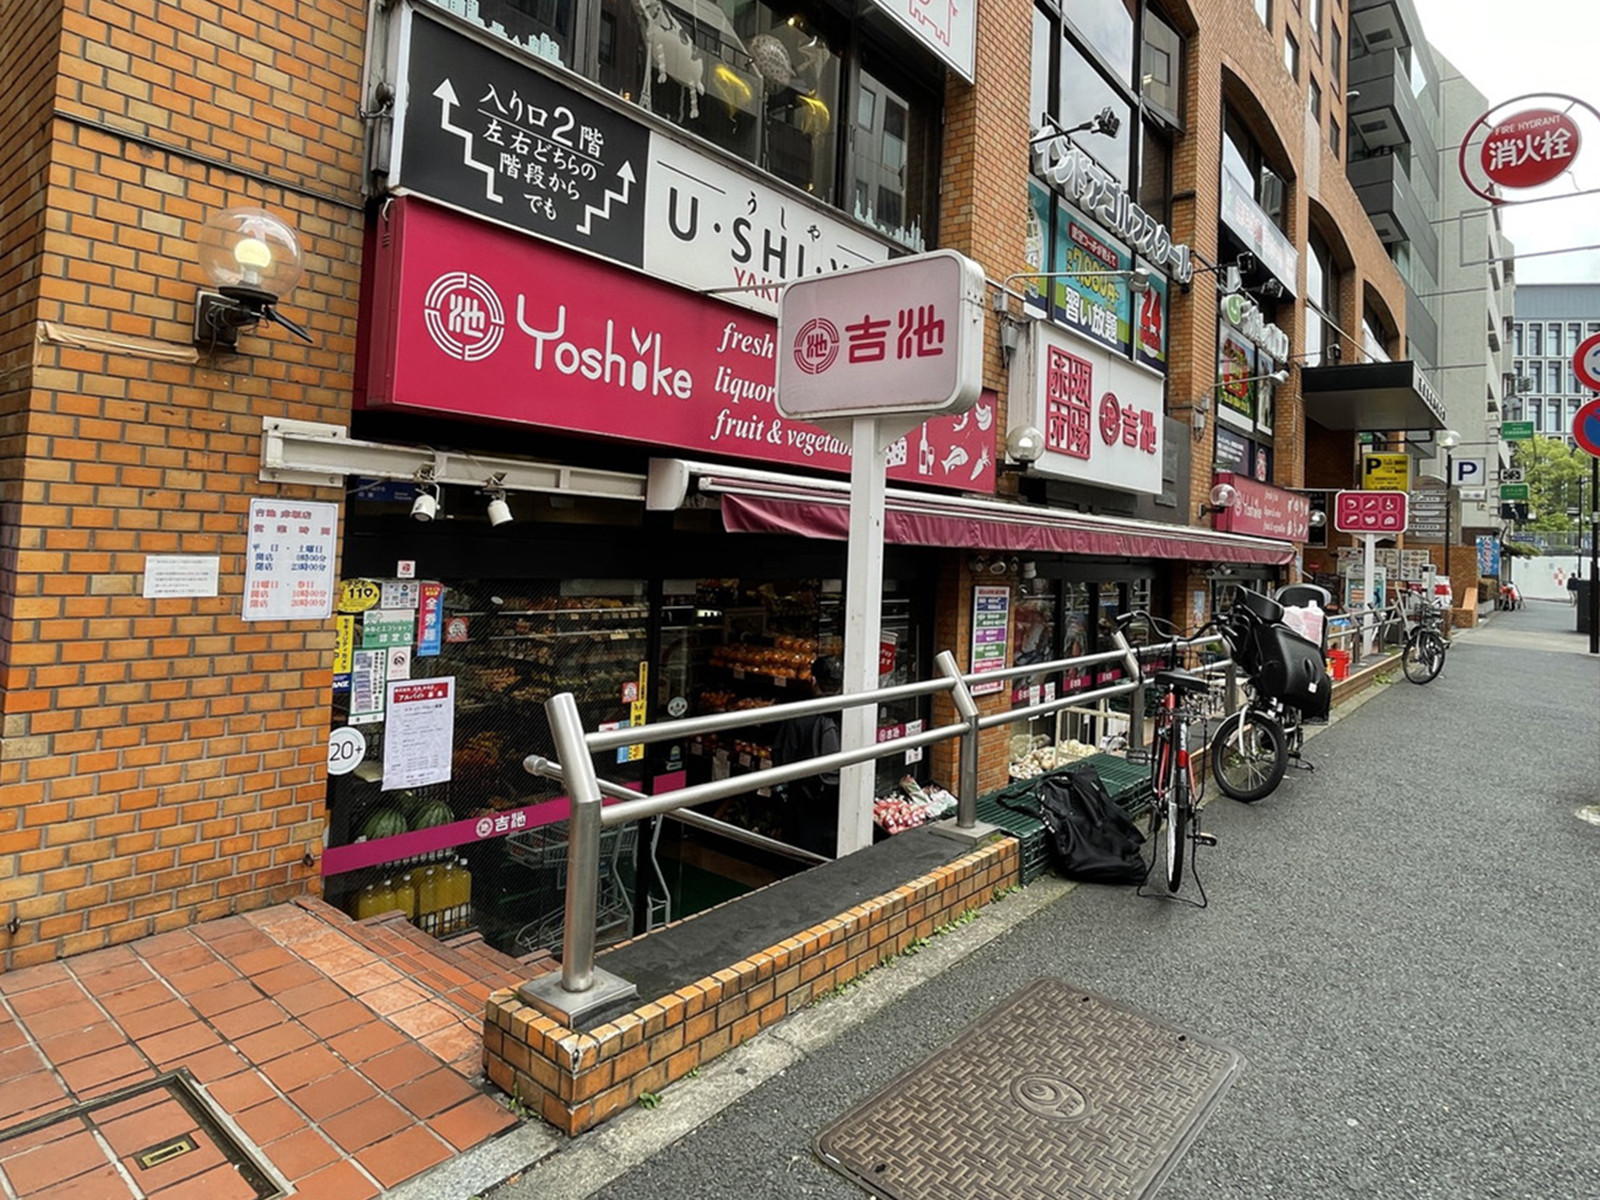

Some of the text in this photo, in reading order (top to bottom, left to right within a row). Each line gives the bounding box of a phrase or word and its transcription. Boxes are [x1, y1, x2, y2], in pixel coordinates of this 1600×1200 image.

[479, 83, 604, 158] 入り口2階
[1494, 115, 1561, 135] FIRE HYDRANT
[483, 119, 597, 181] 左右どちらの
[1488, 127, 1571, 170] 消火栓
[499, 152, 580, 200] 階段から
[523, 193, 557, 220] でも
[747, 191, 821, 242] うしや
[845, 304, 945, 363] 吉池
[1065, 286, 1117, 345] 習い放題
[516, 293, 692, 399] Yoshike
[716, 322, 774, 359] fresh
[714, 366, 776, 404] liquor
[710, 408, 764, 442] fruit
[767, 419, 782, 445] &
[1121, 404, 1156, 454] 吉池
[1366, 458, 1382, 475] P
[1458, 461, 1477, 481] P
[329, 740, 363, 762] 20+
[494, 811, 527, 832] 吉池
